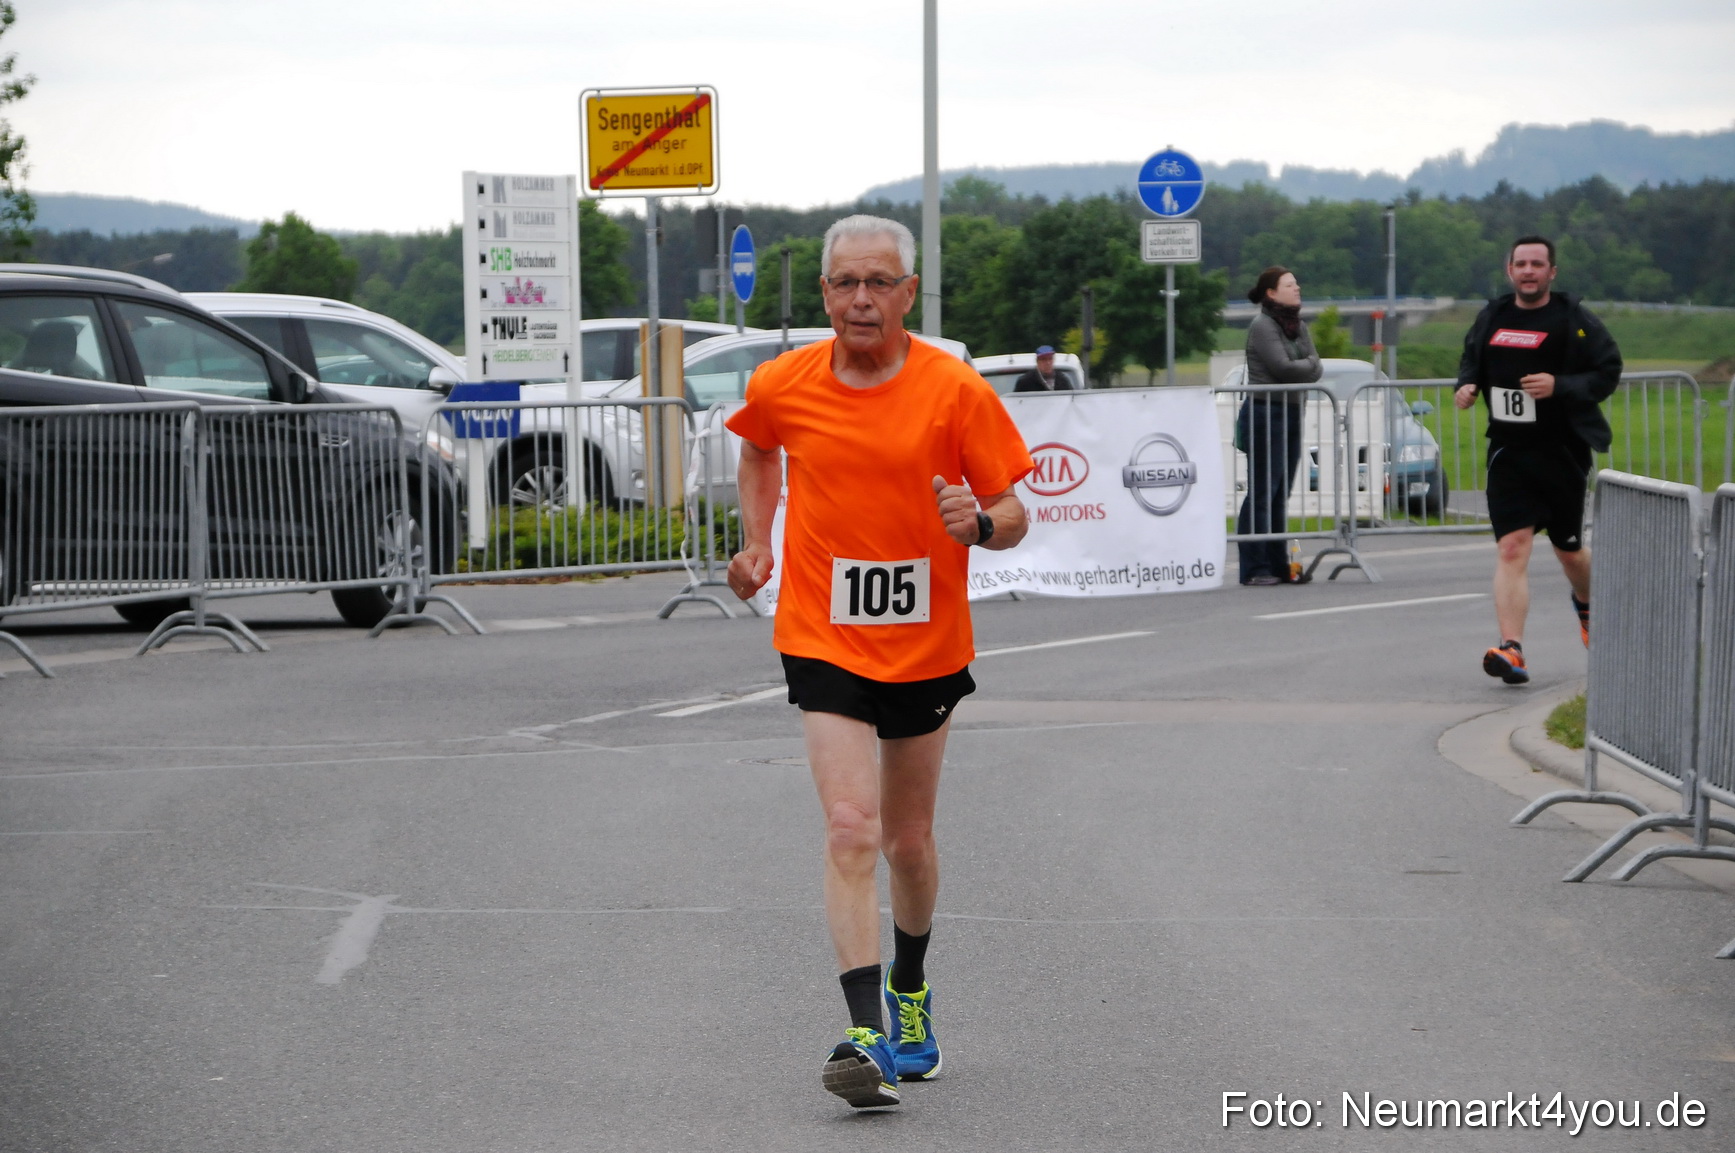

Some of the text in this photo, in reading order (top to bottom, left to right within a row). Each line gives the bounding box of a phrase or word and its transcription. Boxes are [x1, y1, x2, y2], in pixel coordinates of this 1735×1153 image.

[598, 105, 701, 136] Sengenthal
[612, 137, 688, 154] am Anger
[624, 164, 669, 177] Neumarkt
[511, 176, 555, 191] HOLZAMMER
[512, 211, 556, 225] HOLZAMMER
[491, 315, 527, 340] THULE
[1503, 390, 1525, 417] 18
[1032, 455, 1075, 484] KIA
[1131, 467, 1190, 483] NISSAN
[1036, 502, 1106, 523] MOTORS
[1039, 557, 1215, 591] www.gerhart-jaenig.de
[844, 565, 916, 617] 105
